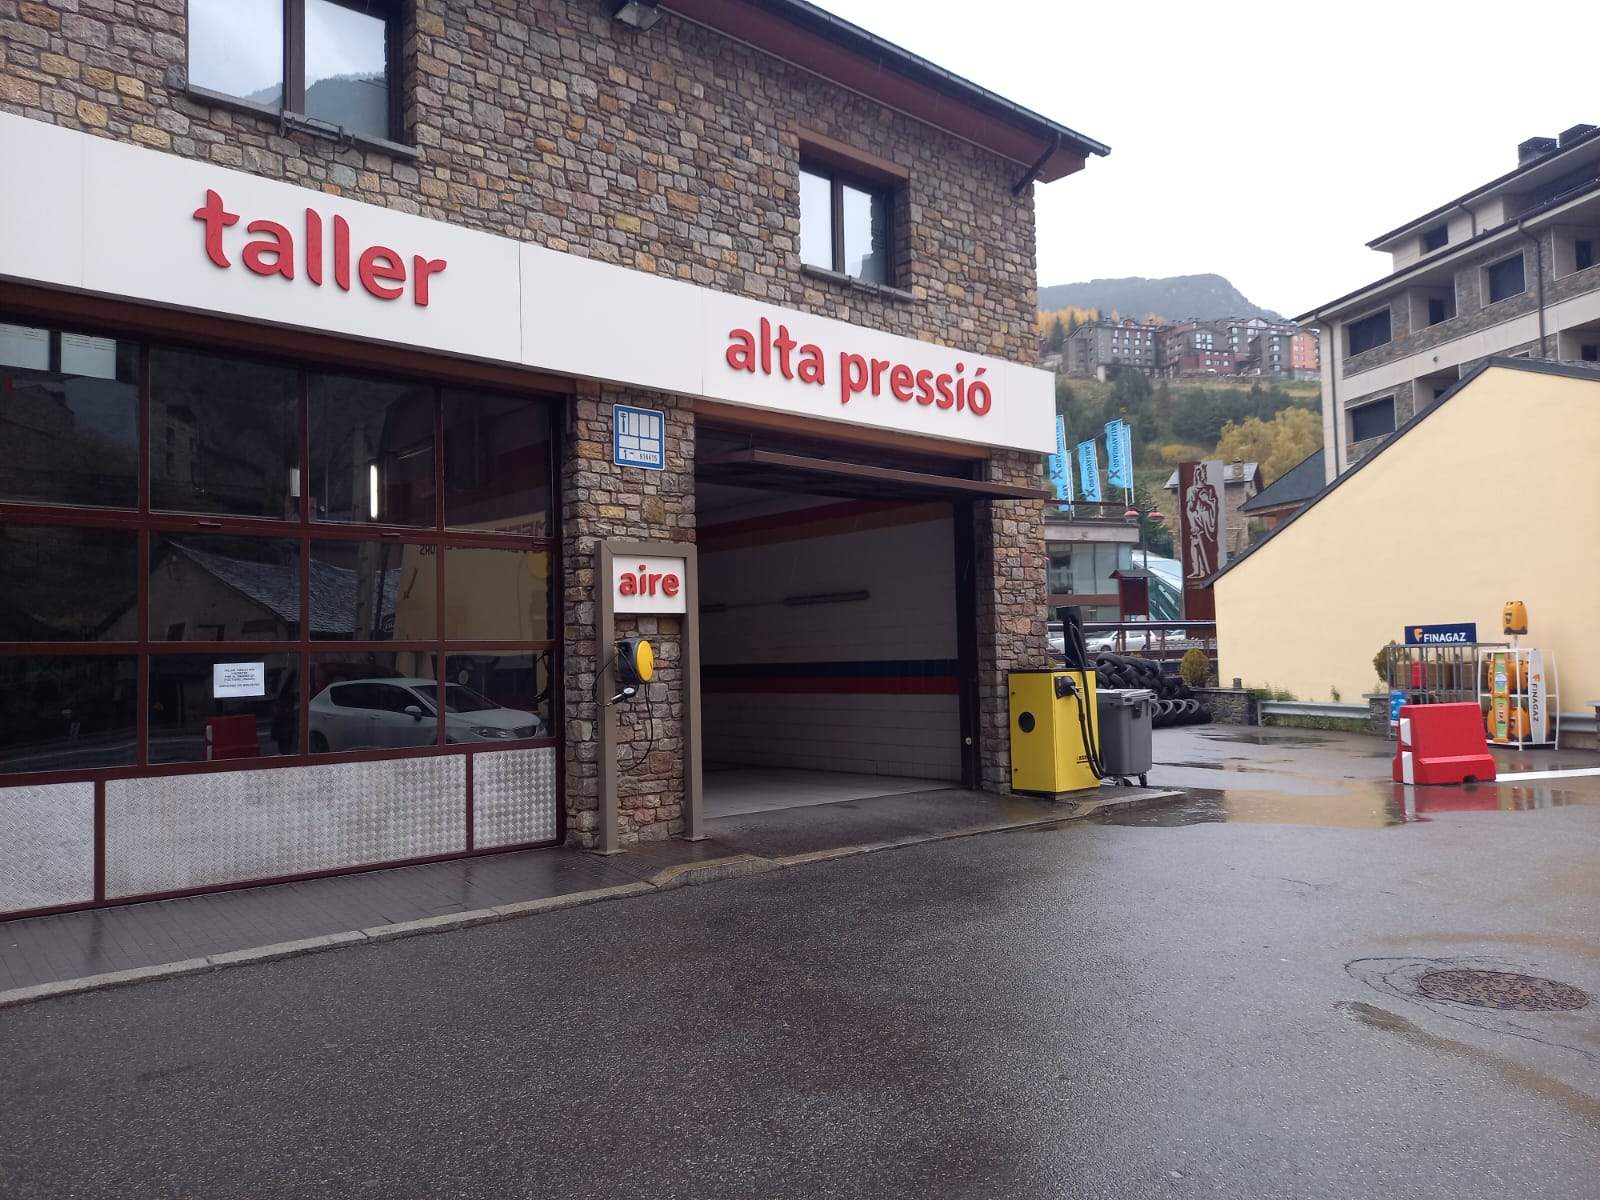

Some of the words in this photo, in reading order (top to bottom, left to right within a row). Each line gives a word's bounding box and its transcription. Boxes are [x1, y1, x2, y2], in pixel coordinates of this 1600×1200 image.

[192, 188, 447, 307] taller
[725, 316, 825, 386] alta
[840, 350, 992, 417] pressió
[619, 564, 680, 597] aire
[1423, 632, 1467, 643] FINAGAZ
[1531, 683, 1540, 722] FINAGAZ
